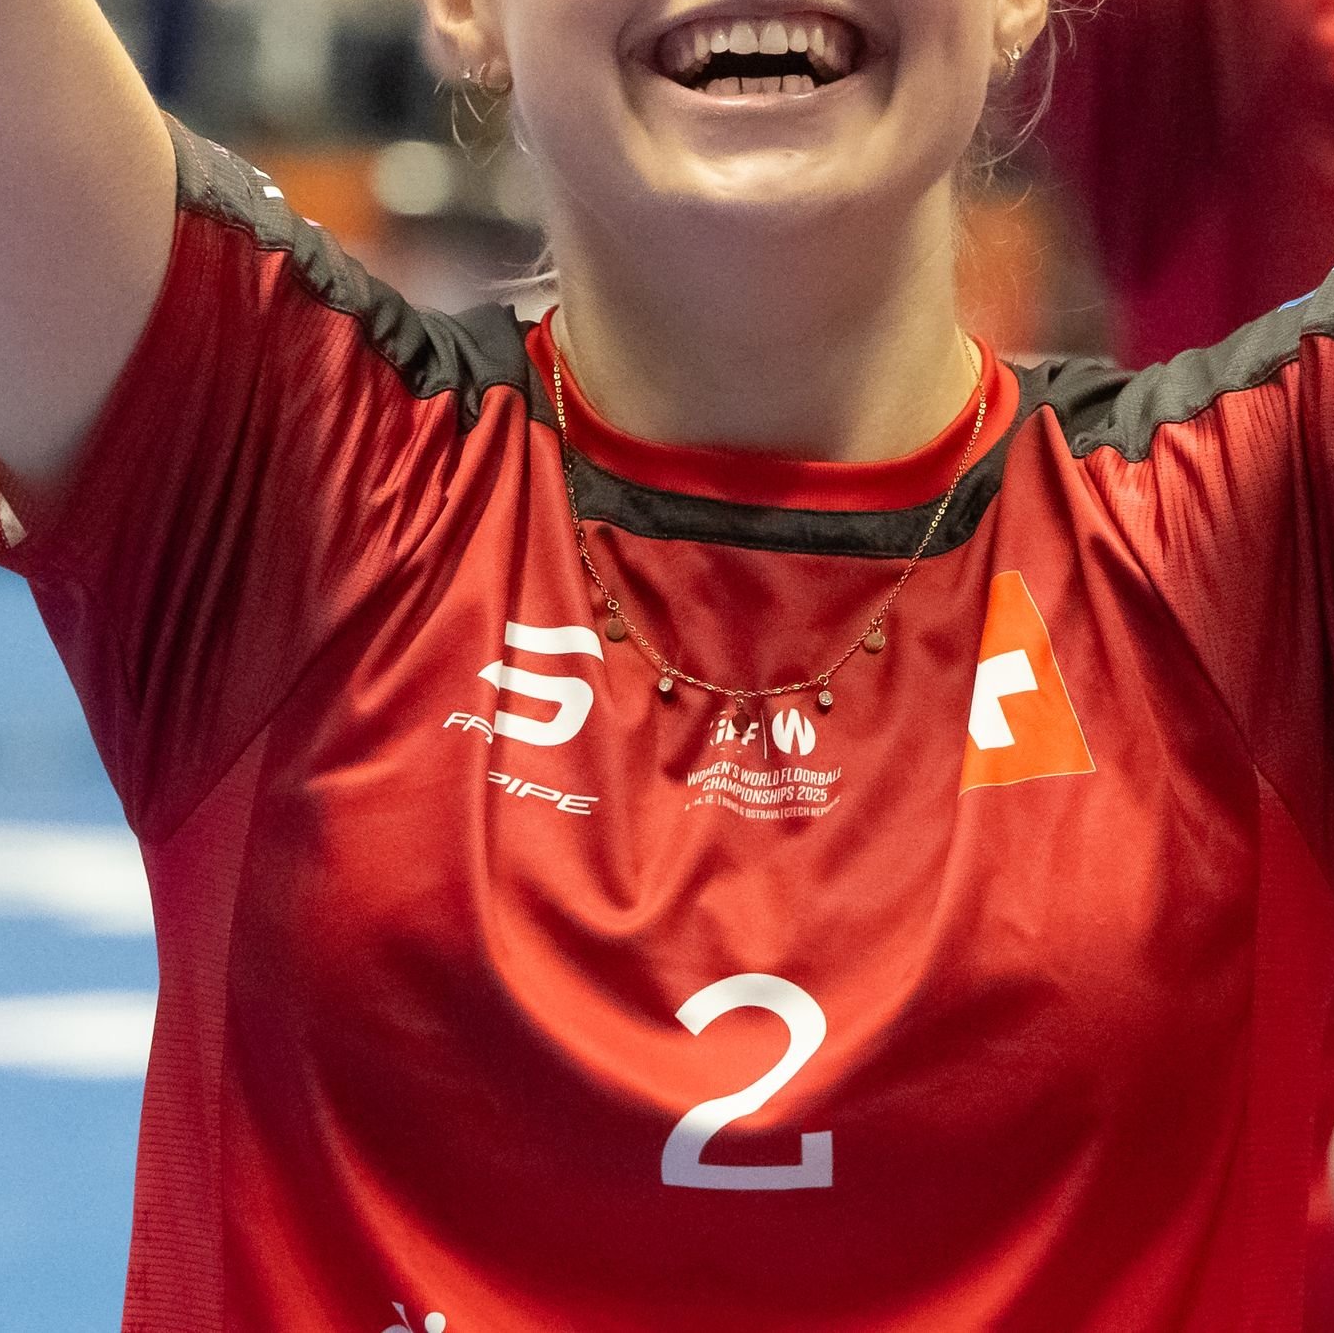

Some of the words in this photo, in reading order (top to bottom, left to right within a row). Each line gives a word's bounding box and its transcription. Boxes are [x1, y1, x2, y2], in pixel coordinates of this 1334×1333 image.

[687, 760, 740, 787] WOMEN'S
[740, 768, 780, 787] WORLD
[780, 766, 842, 786] FLOORBALL
[702, 776, 795, 804] CHAMPIONSHIPS
[796, 785, 828, 802] 2025
[746, 808, 779, 819] OSTRAVA
[784, 806, 809, 818] CZECH
[661, 972, 834, 1190] 2
